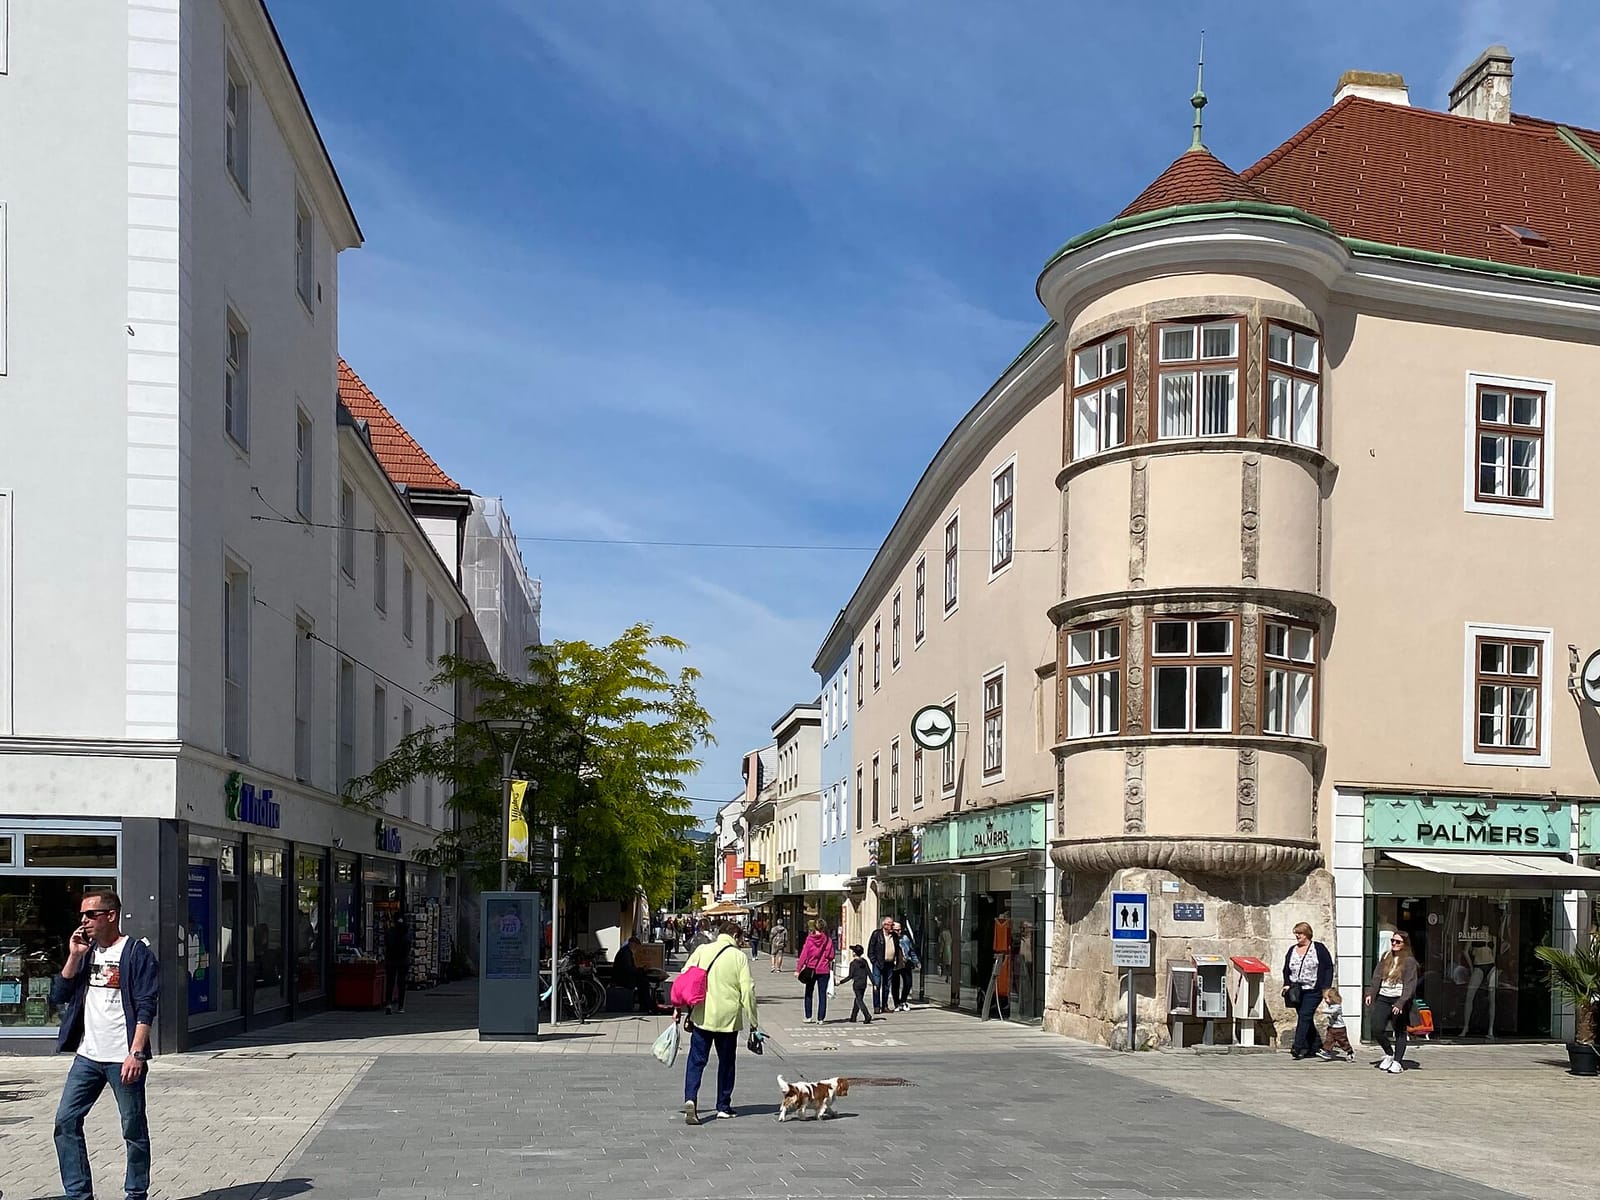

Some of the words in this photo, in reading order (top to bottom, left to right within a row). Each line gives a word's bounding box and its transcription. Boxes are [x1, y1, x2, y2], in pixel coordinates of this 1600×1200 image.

[241, 782, 280, 829] Thalia
[974, 830, 1009, 847] PALMERS
[1417, 823, 1540, 845] PALMERS
